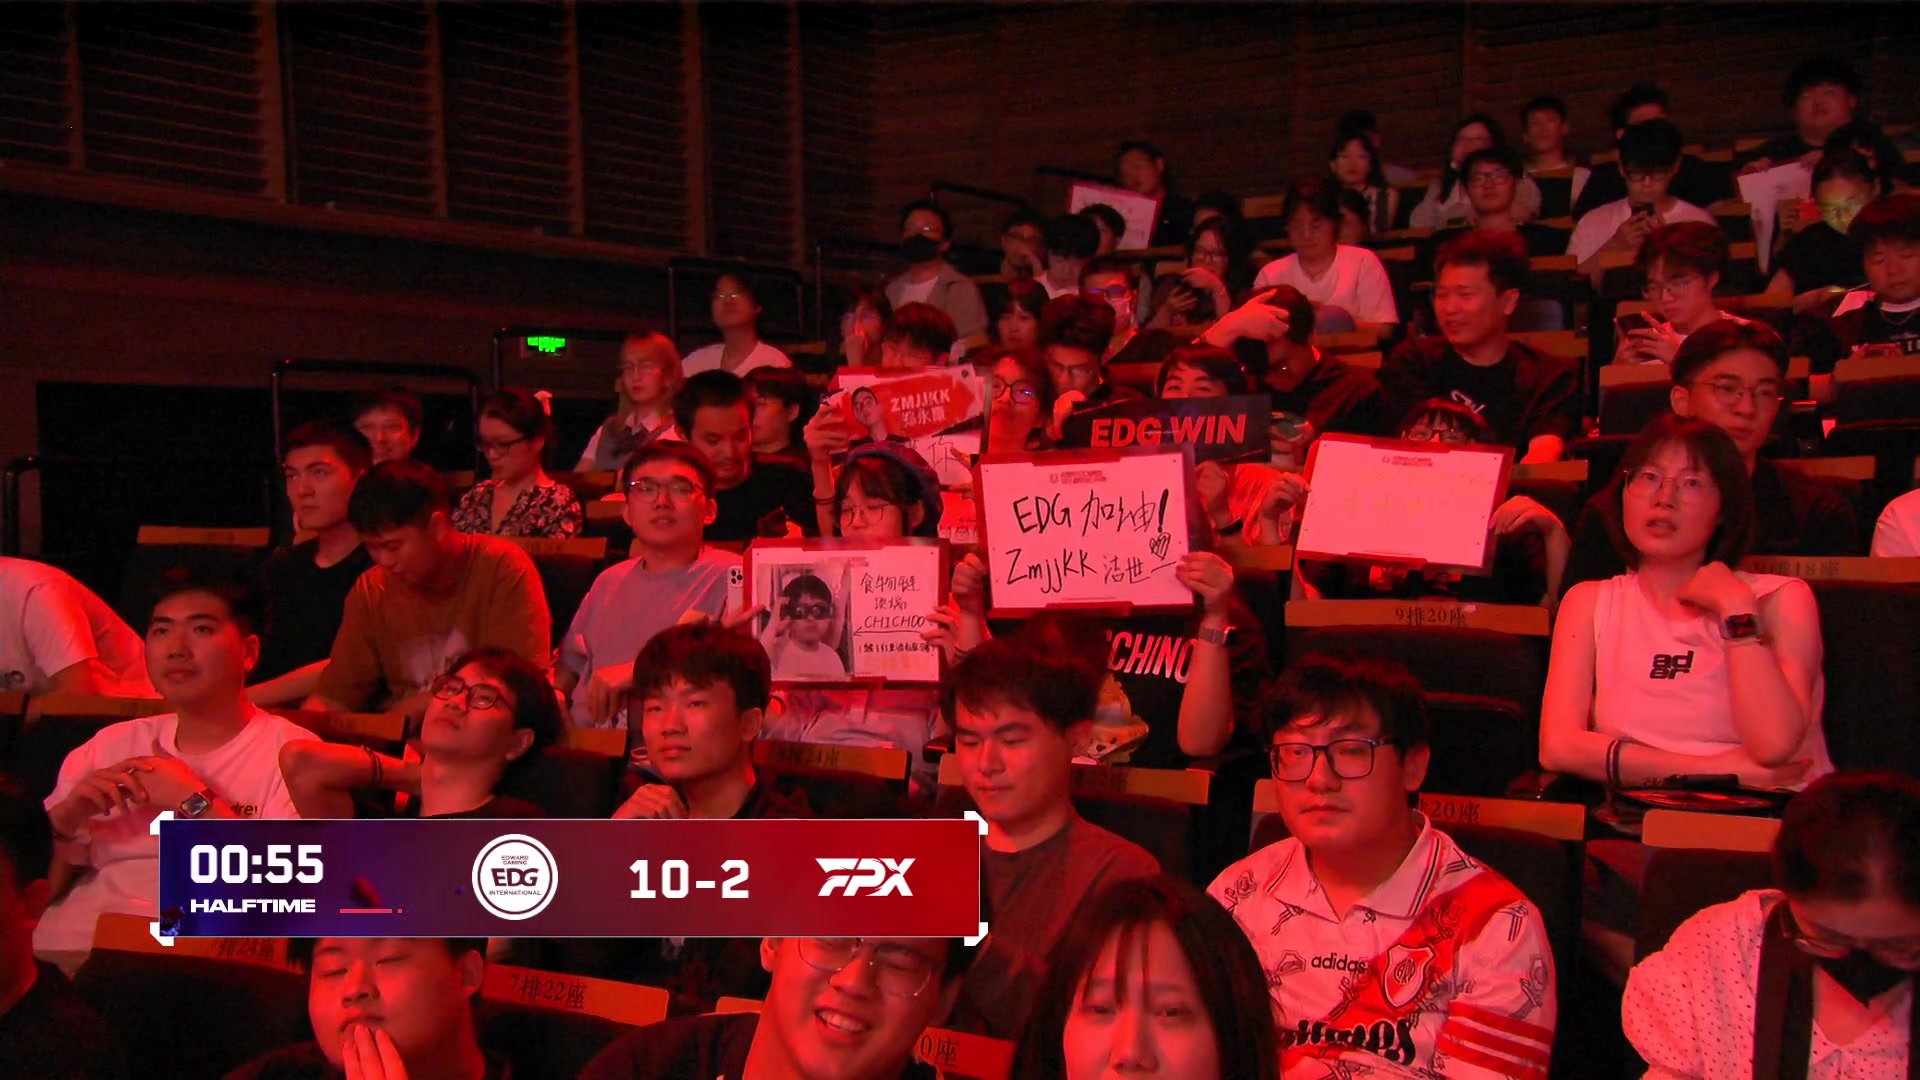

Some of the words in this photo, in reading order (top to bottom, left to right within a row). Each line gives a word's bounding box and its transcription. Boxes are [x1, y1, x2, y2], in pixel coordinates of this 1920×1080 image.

[1091, 417, 1162, 448] EDG
[1170, 414, 1247, 444] WIN
[1013, 493, 1072, 533] EDG
[1106, 630, 1198, 684] CHINO
[1311, 952, 1368, 975] adidas
[511, 973, 586, 1010] 7排22座
